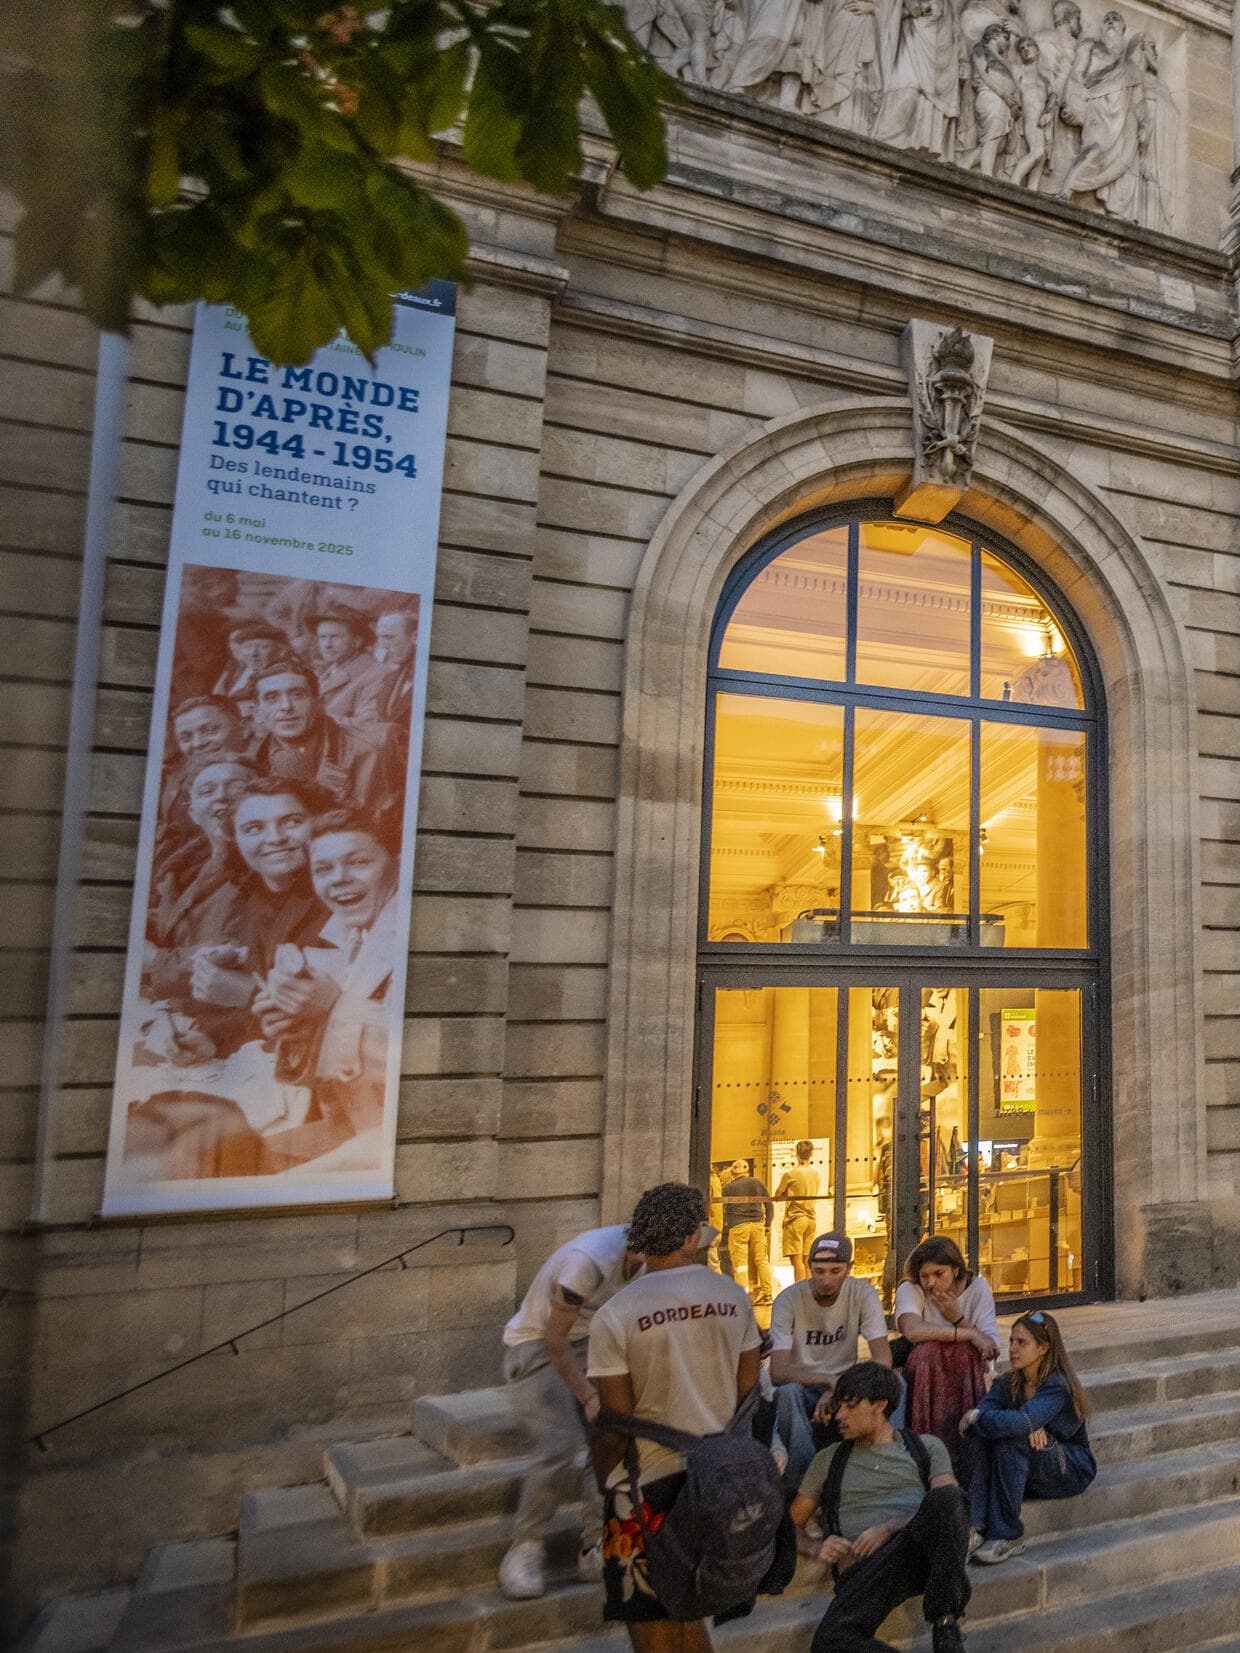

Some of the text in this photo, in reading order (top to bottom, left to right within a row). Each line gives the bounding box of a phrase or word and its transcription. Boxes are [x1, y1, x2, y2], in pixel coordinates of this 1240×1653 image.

[220, 352, 420, 413] LE MONDE
[216, 386, 393, 444] D'APRÈS,
[208, 454, 377, 494] Des lendemains
[206, 478, 242, 495] qui
[248, 482, 343, 511] chantent
[204, 511, 266, 528] du 6 mai
[202, 527, 354, 556] au 16 novembre 2025
[638, 1303, 738, 1332] BORDEAUX
